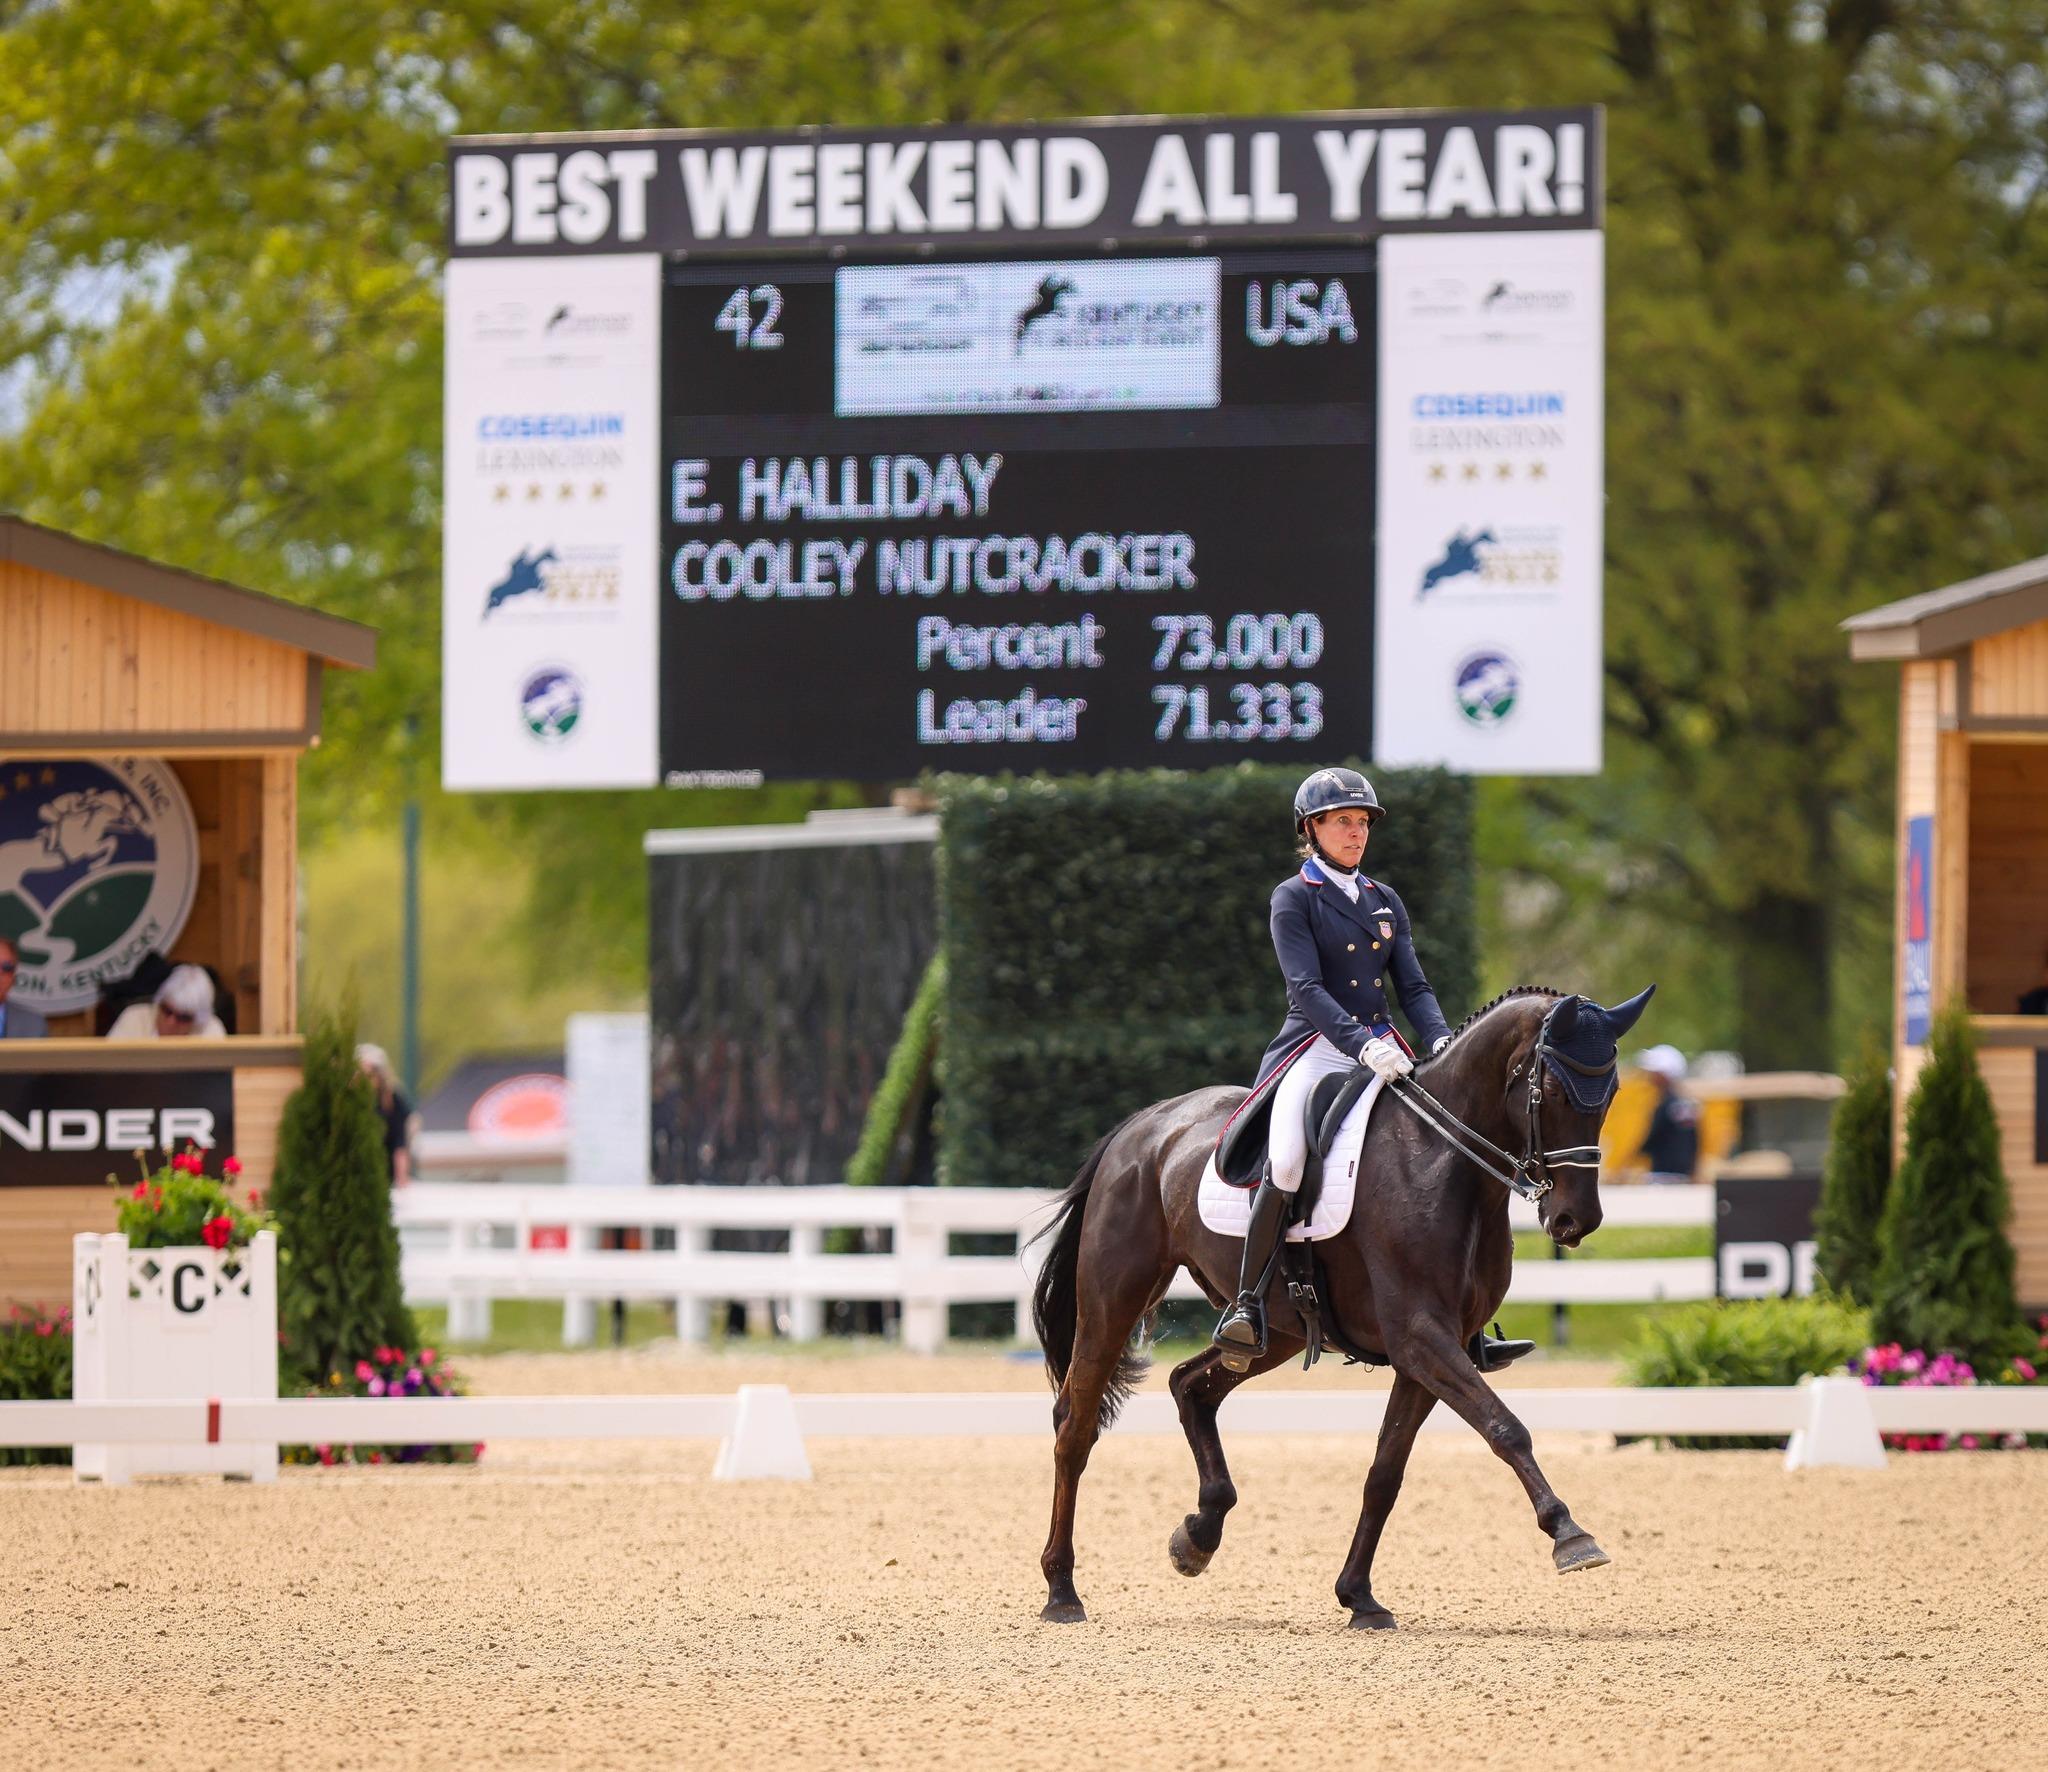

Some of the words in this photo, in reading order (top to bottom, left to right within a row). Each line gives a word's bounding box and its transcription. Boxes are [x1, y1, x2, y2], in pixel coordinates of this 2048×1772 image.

[453, 149, 658, 246] BEST
[678, 136, 1110, 241] WEEKEND
[1131, 131, 1299, 228] ALL
[1313, 123, 1585, 221] YEAR!
[714, 284, 785, 350] 42
[1246, 277, 1359, 347] USA
[478, 414, 623, 440] COSEQUIN
[1413, 391, 1564, 418] COSEQUIN
[1411, 423, 1565, 449] LEXINGTON
[671, 458, 724, 524] E.
[739, 452, 1003, 523] HALLIDAY
[671, 538, 868, 601] COOLEY
[876, 532, 1198, 596] NUTCRACKER
[916, 612, 1105, 671] Percent
[1151, 611, 1325, 671] 73.000
[916, 684, 1087, 744] Leader
[1151, 682, 1325, 742] 71.333
[173, 1264, 205, 1313] C
